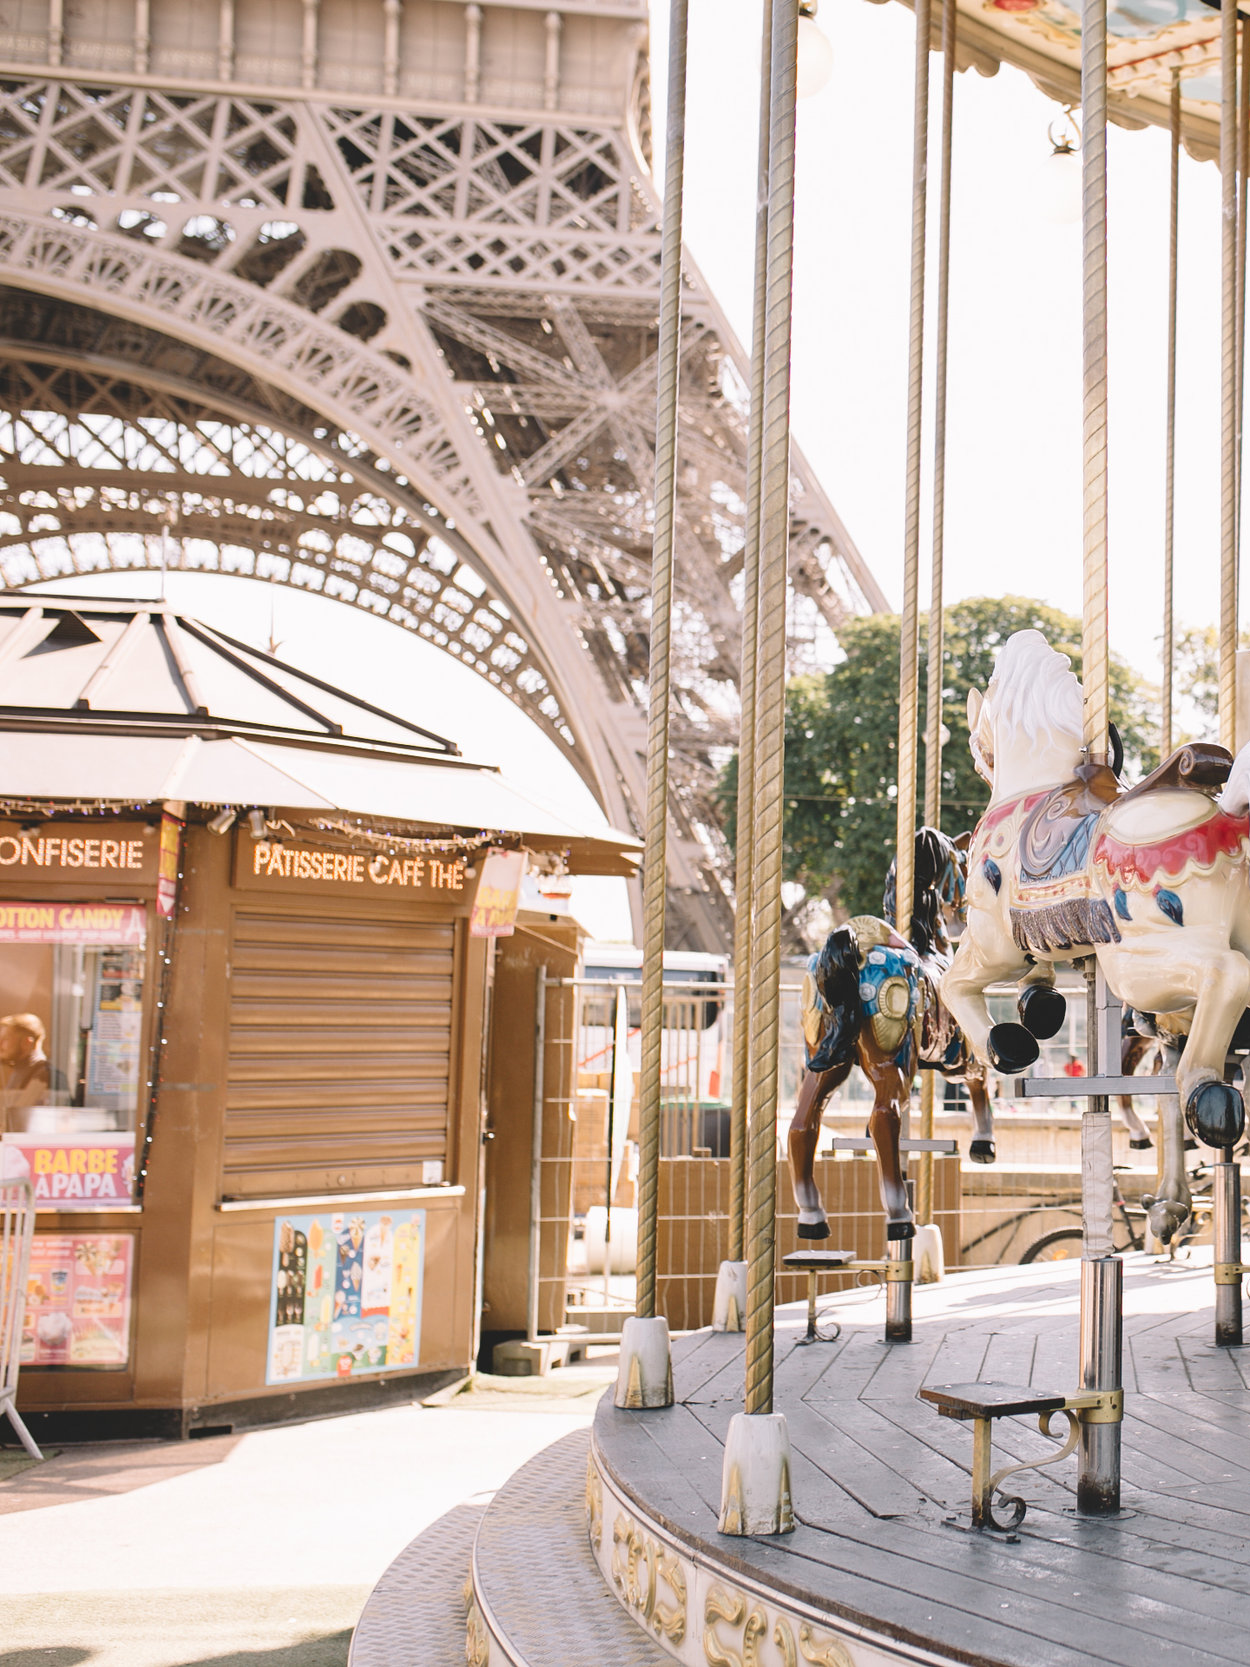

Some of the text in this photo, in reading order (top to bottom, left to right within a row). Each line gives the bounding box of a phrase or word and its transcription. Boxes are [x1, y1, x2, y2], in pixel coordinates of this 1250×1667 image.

[0, 837, 143, 868] ONFISERIE
[368, 854, 424, 887] CAFÉ
[0, 906, 125, 930] OTTON CANDY
[34, 1148, 119, 1174] BARBE
[51, 1173, 117, 1198] PAPA
